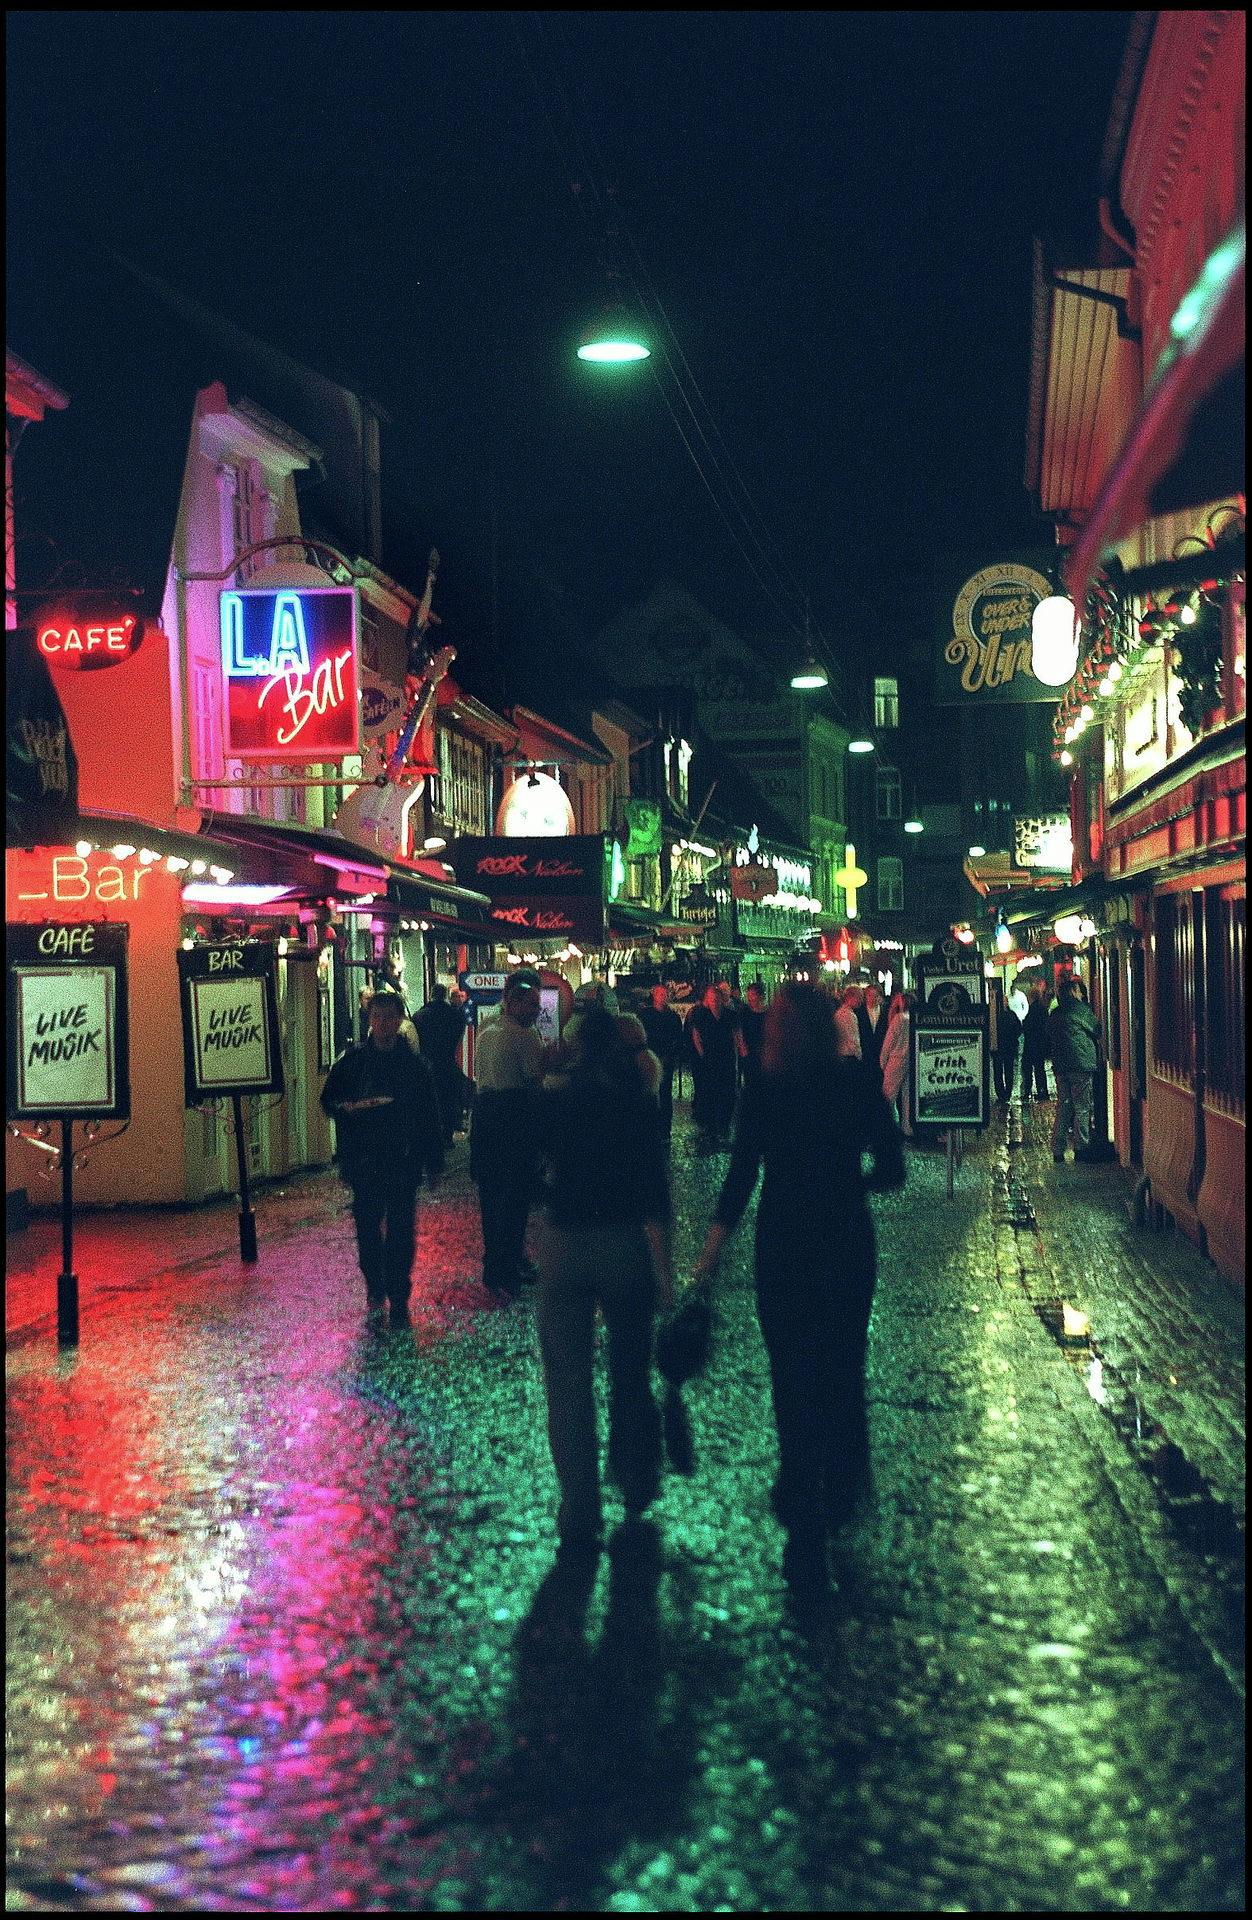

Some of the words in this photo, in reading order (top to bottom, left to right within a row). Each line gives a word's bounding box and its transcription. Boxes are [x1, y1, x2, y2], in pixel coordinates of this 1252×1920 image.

[40, 619, 134, 652] CAFÉ
[981, 613, 1031, 634] UNDER
[257, 650, 352, 745] Bar
[38, 925, 95, 954] CAFÉ
[208, 950, 245, 971] BAR
[474, 977, 499, 987] ONE
[36, 1004, 89, 1036] LIVE
[208, 1004, 252, 1030] LIVE
[28, 1028, 101, 1057] MUSIK
[204, 1024, 262, 1053] MUSIK
[934, 1055, 968, 1069] Irish
[927, 1072, 974, 1085] Coffee
